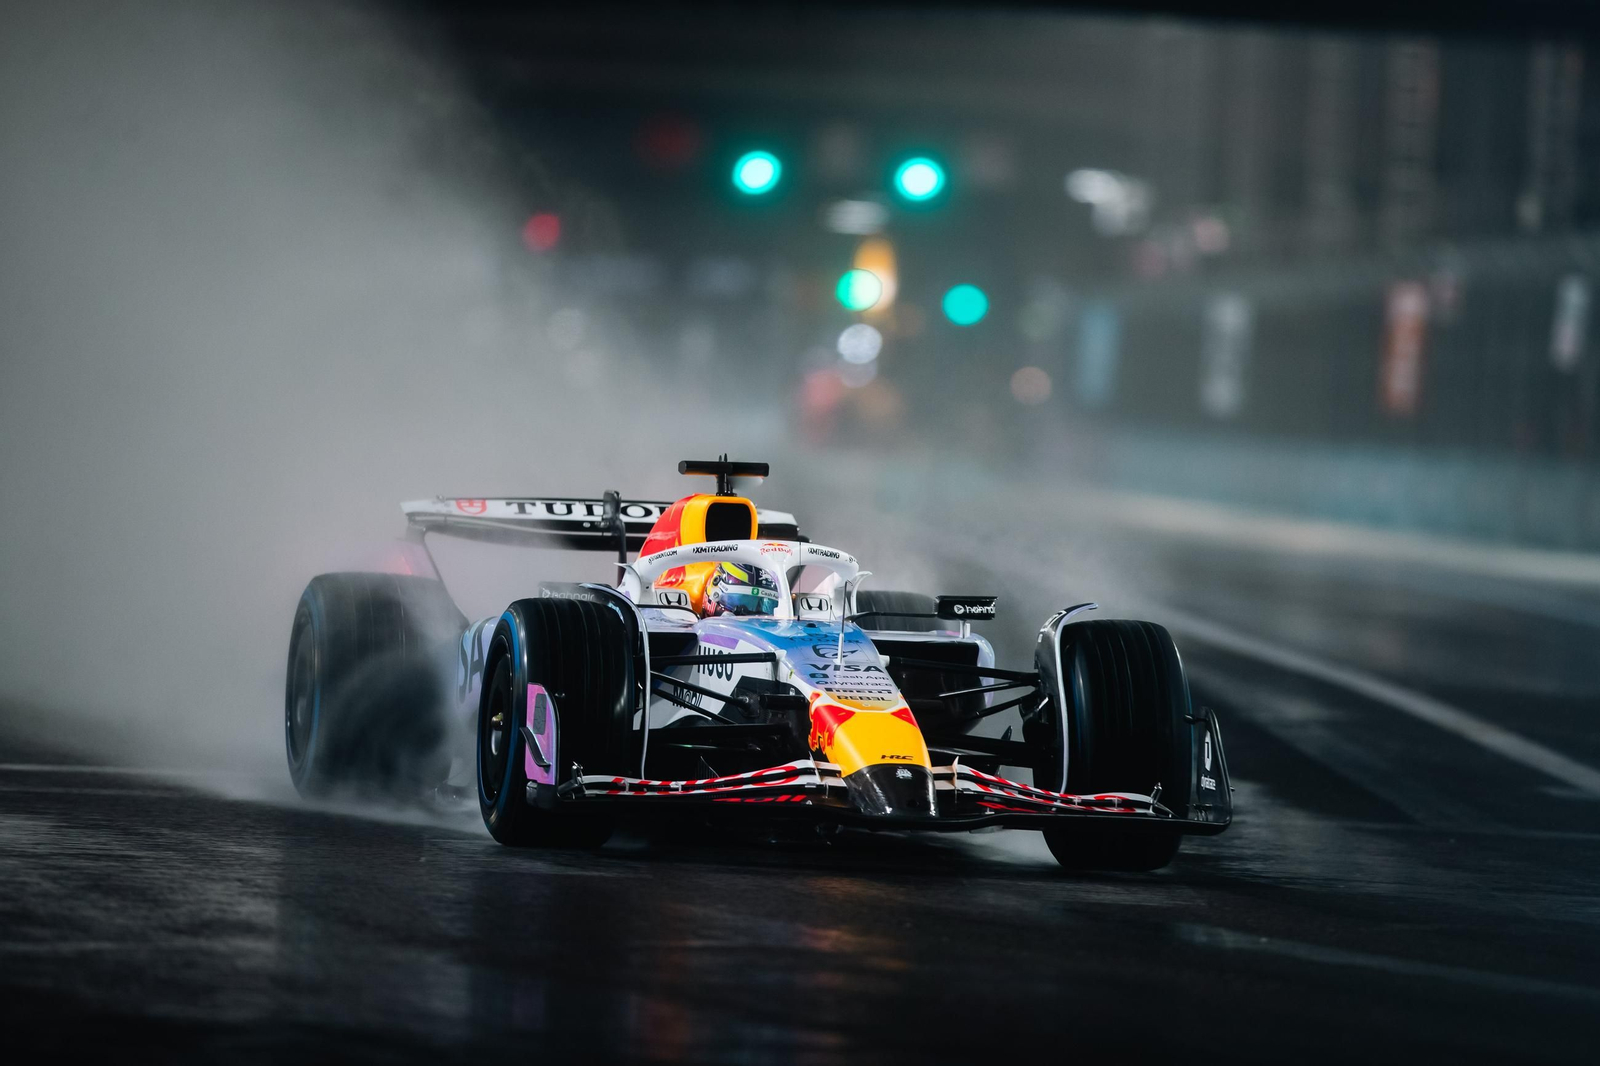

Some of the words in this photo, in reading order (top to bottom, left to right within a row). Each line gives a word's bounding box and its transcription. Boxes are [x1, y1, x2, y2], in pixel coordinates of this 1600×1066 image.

[505, 501, 669, 519] TUDO
[697, 645, 734, 681] HUGO
[802, 663, 885, 674] VISA
